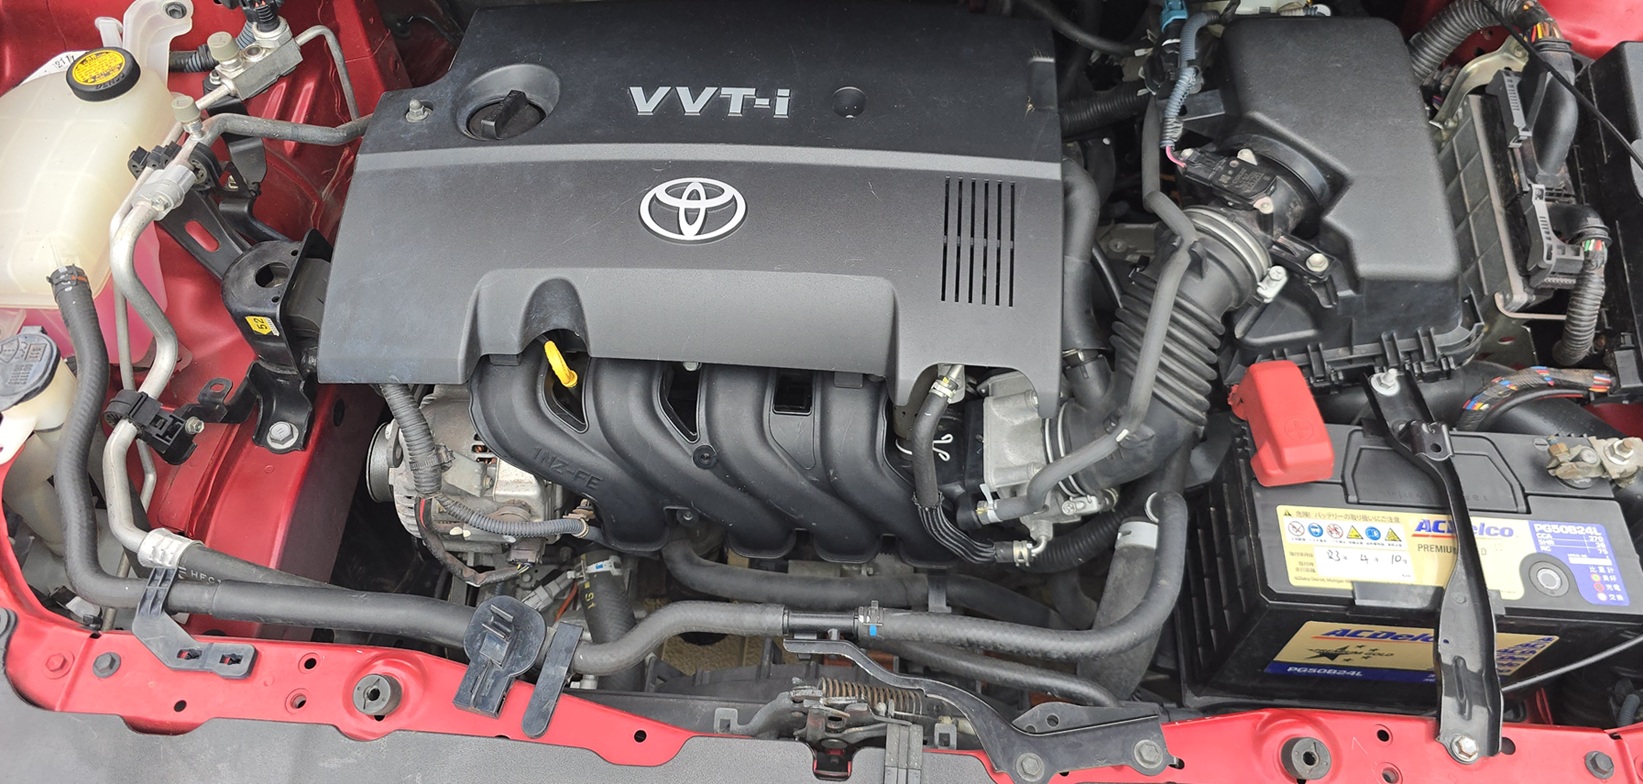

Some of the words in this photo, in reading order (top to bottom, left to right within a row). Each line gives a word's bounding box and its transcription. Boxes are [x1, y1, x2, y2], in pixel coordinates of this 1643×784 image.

[628, 86, 791, 119] VVT-i
[253, 317, 268, 330] 52
[532, 448, 603, 491] 1NZ-FE
[1414, 518, 1514, 538] AClco
[1391, 554, 1402, 565] 10
[1321, 628, 1434, 643] ACDelc
[1287, 666, 1363, 677] PG50B24L
